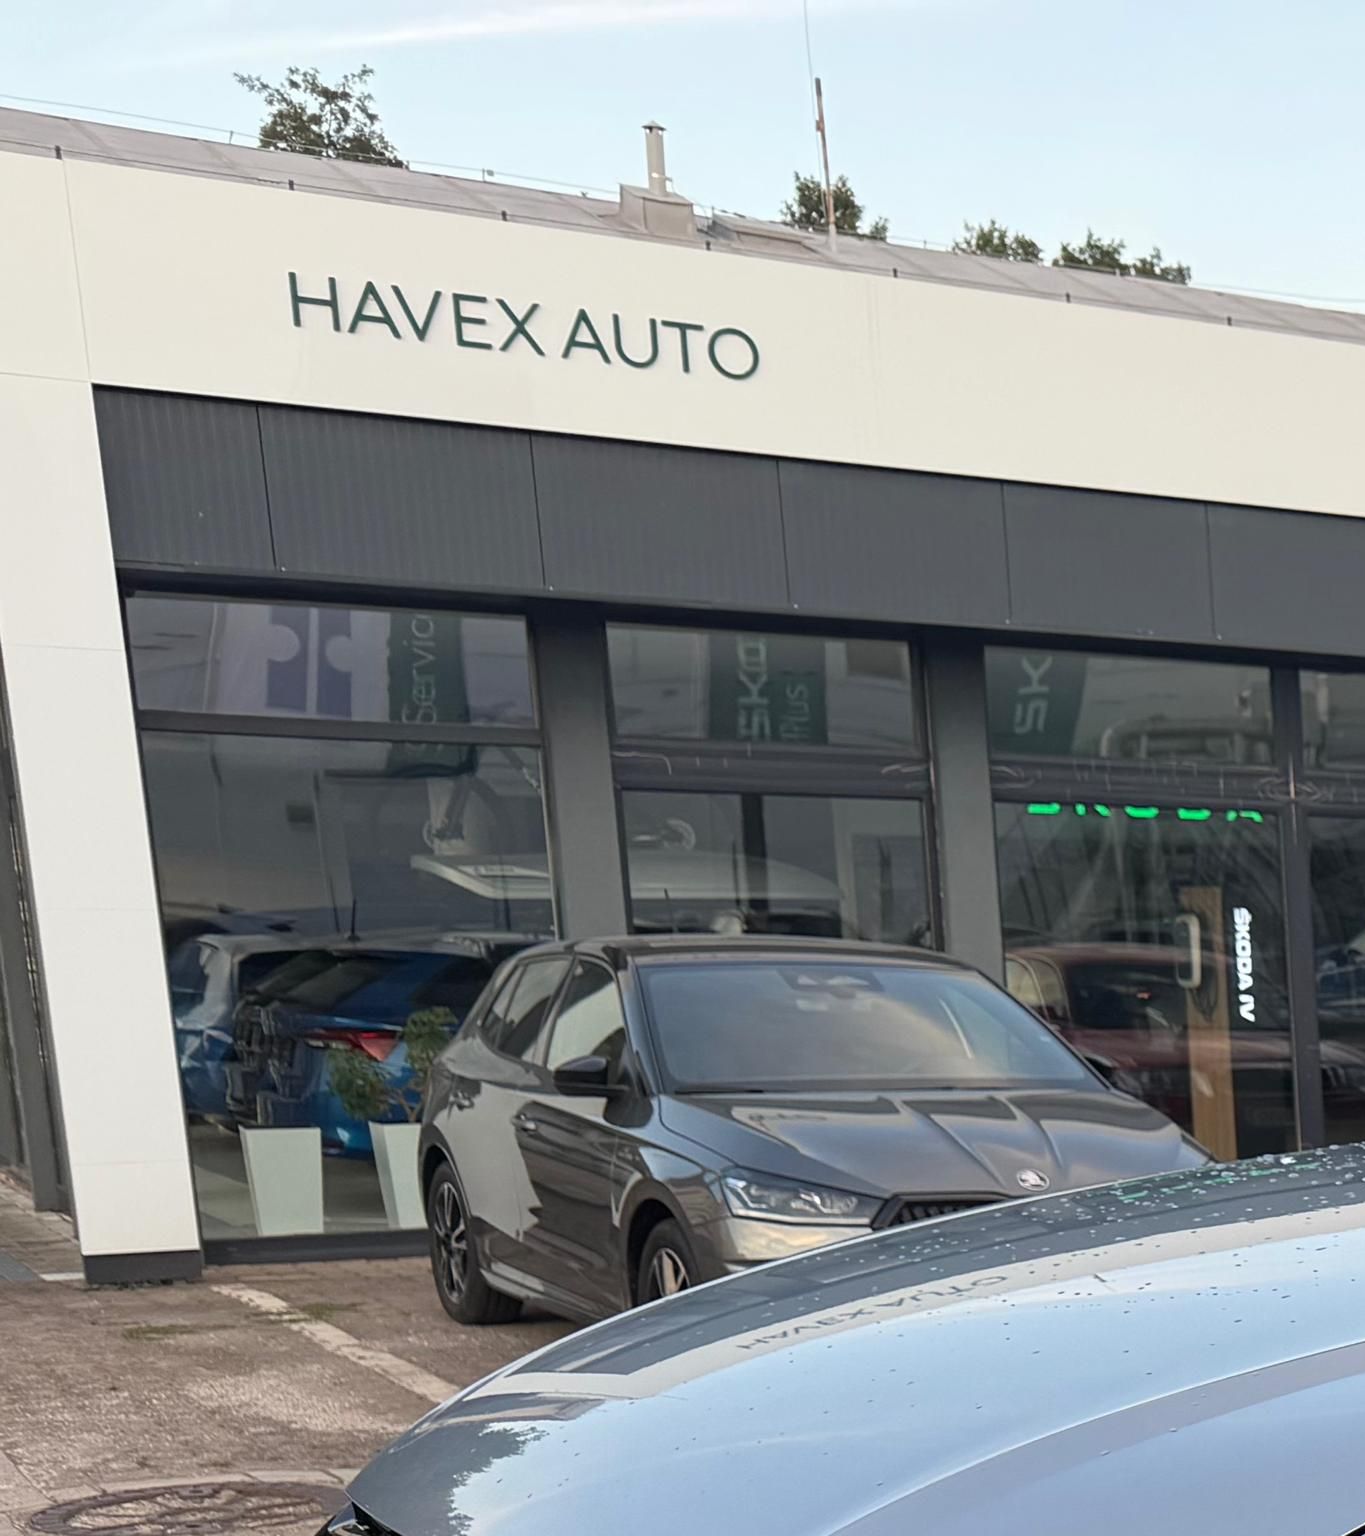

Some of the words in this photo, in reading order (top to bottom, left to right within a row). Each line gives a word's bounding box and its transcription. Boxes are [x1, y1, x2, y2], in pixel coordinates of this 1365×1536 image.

[288, 271, 546, 357] HAVEX
[561, 308, 760, 381] AUTO
[402, 614, 437, 725] Servic
